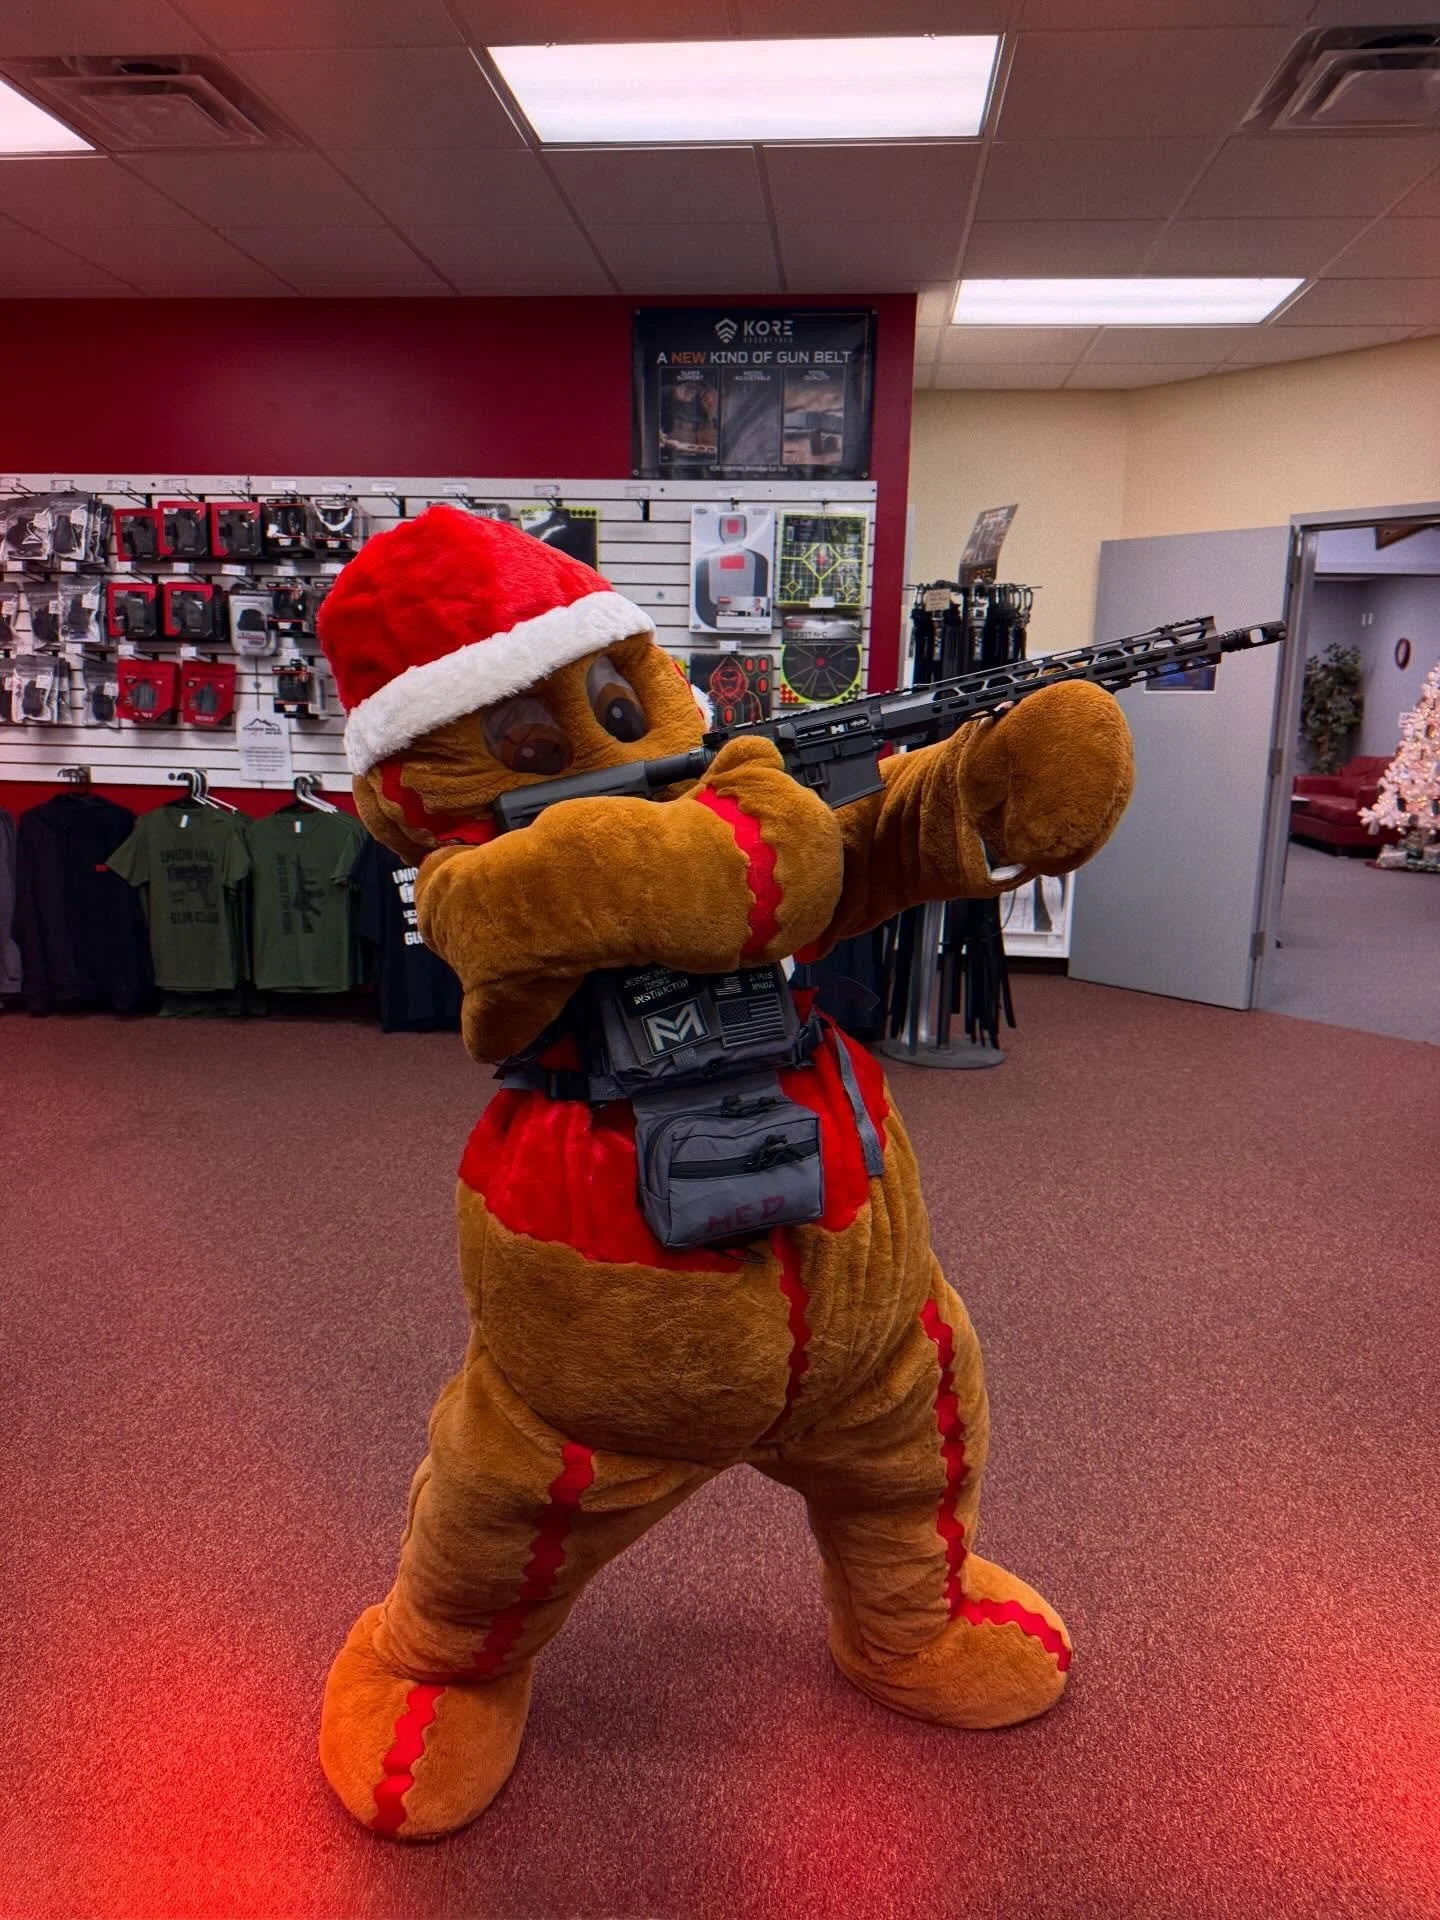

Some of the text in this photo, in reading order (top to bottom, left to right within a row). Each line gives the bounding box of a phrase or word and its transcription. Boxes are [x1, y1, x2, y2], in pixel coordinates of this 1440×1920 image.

[743, 320, 793, 336] KORE
[656, 351, 852, 364] A NEW KIND OF GUN BELT
[392, 866, 419, 884] UNIO
[404, 931, 423, 946] GU
